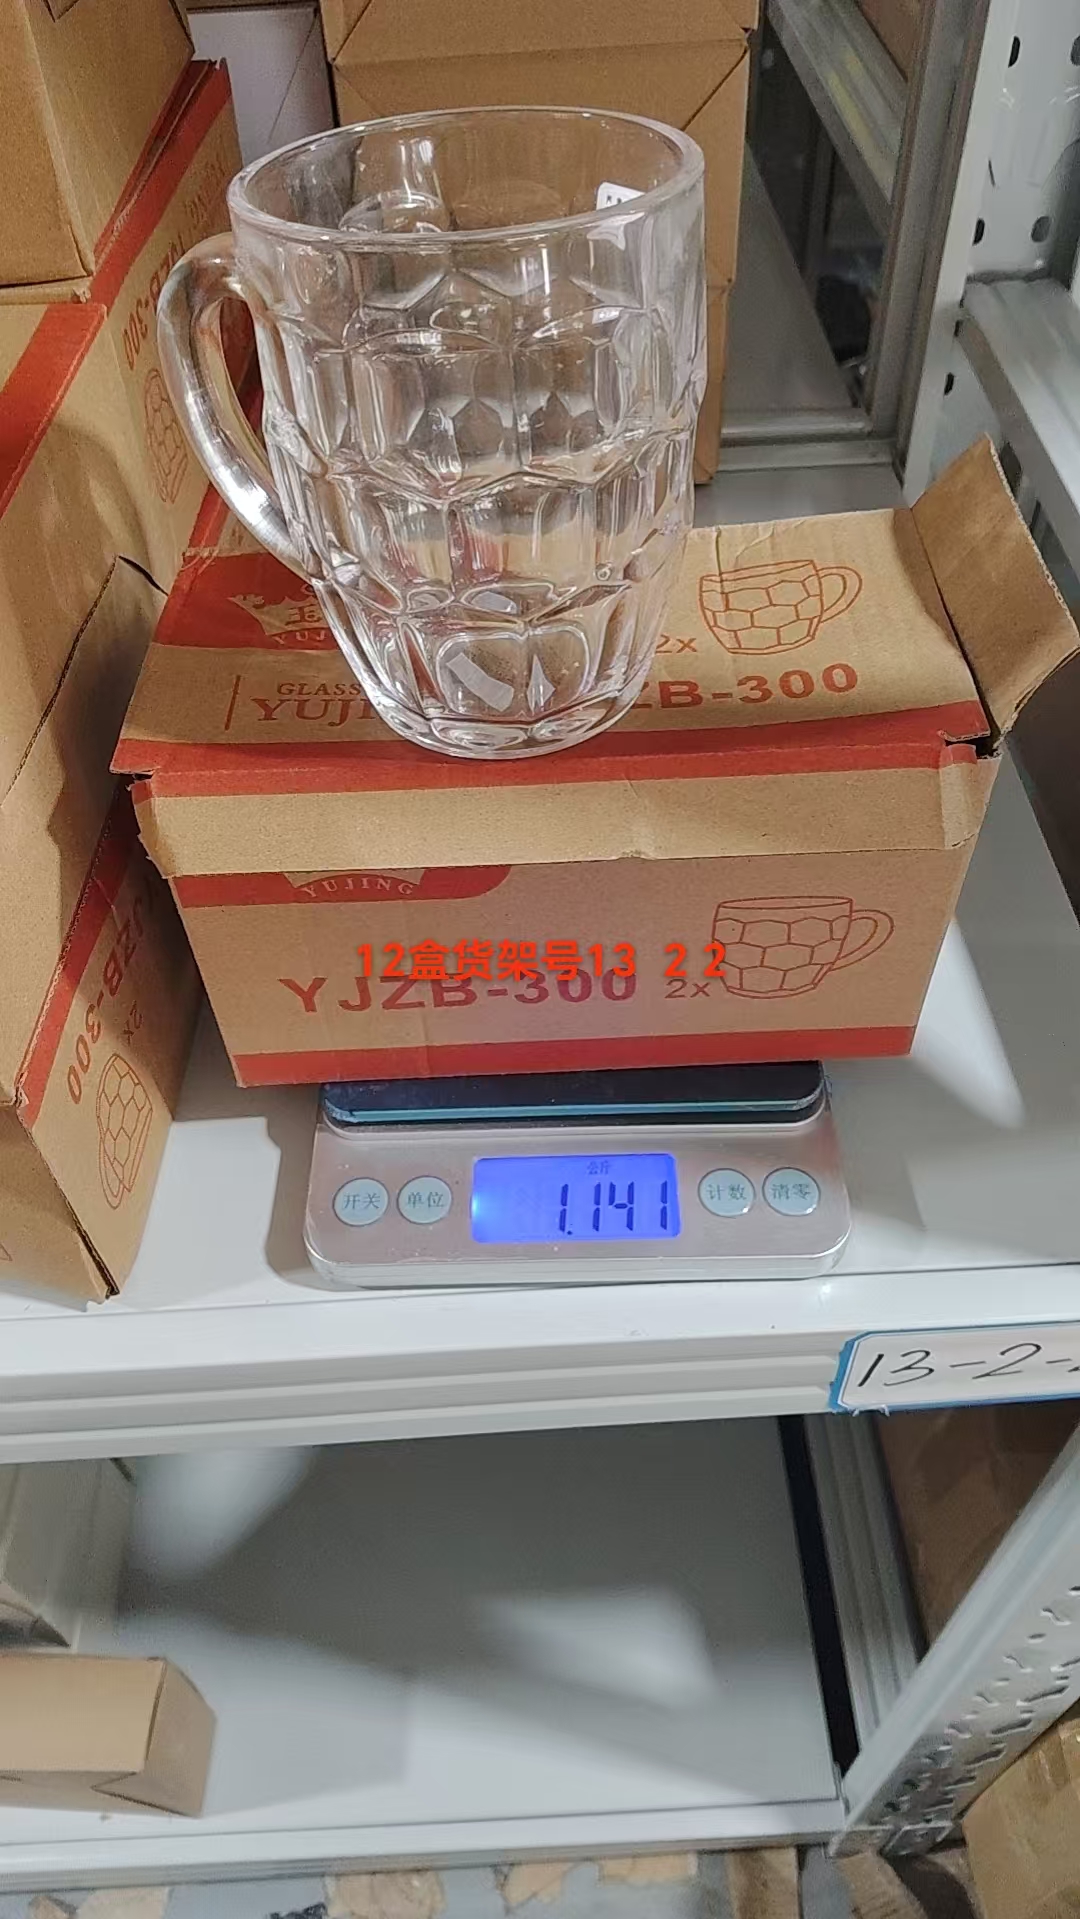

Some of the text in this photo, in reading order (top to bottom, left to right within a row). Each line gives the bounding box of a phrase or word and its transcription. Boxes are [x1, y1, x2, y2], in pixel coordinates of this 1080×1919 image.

[251, 698, 376, 727] YUJI
[302, 877, 415, 898] YUJING
[277, 967, 637, 1013] YJZB-300
[664, 978, 711, 999] 2x
[343, 1192, 381, 1210] 开关
[407, 1191, 445, 1208] 单位
[705, 1183, 747, 1201] 计数
[770, 1182, 811, 1201] 清零
[558, 1180, 668, 1235] 1.141
[857, 1342, 1080, 1388] 13-2-
